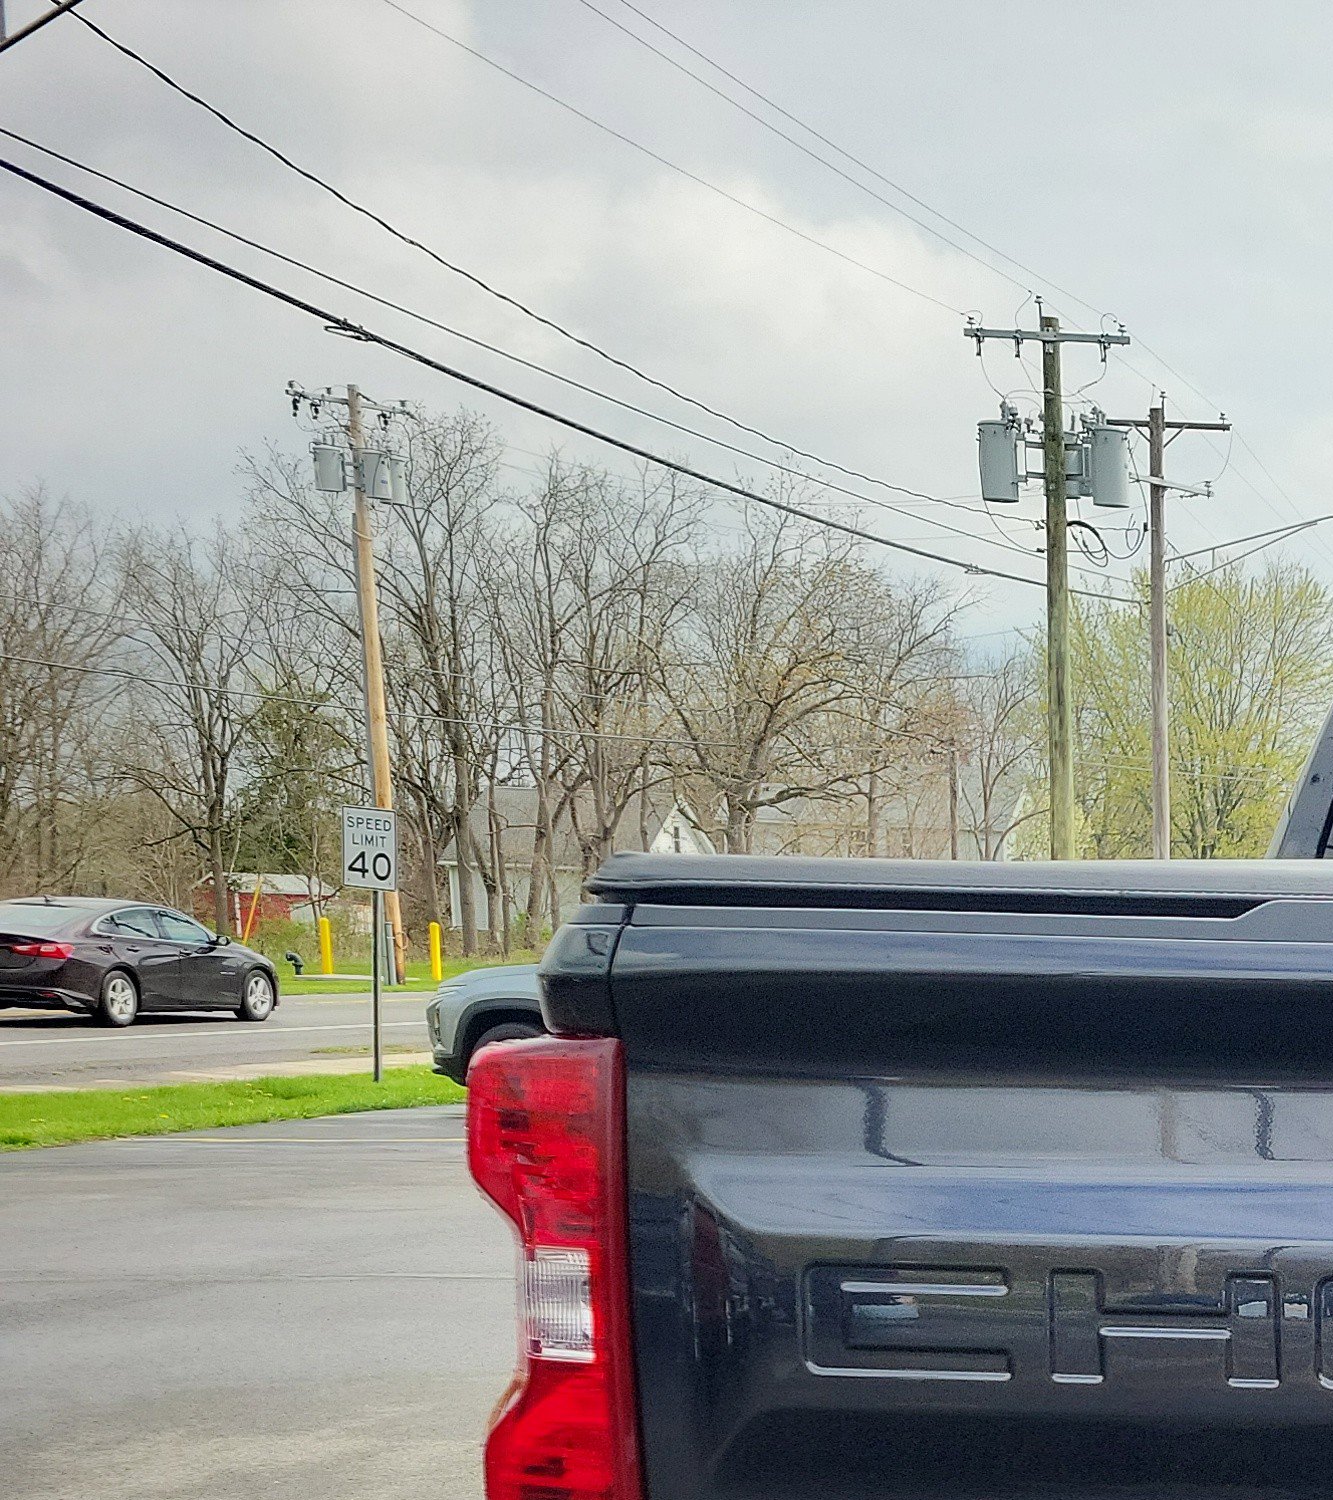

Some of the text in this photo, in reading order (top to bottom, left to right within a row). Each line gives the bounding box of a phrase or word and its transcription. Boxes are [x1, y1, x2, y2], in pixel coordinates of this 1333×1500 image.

[346, 815, 392, 832] SPEED
[352, 833, 387, 848] LIMIT
[347, 851, 392, 881] 40
